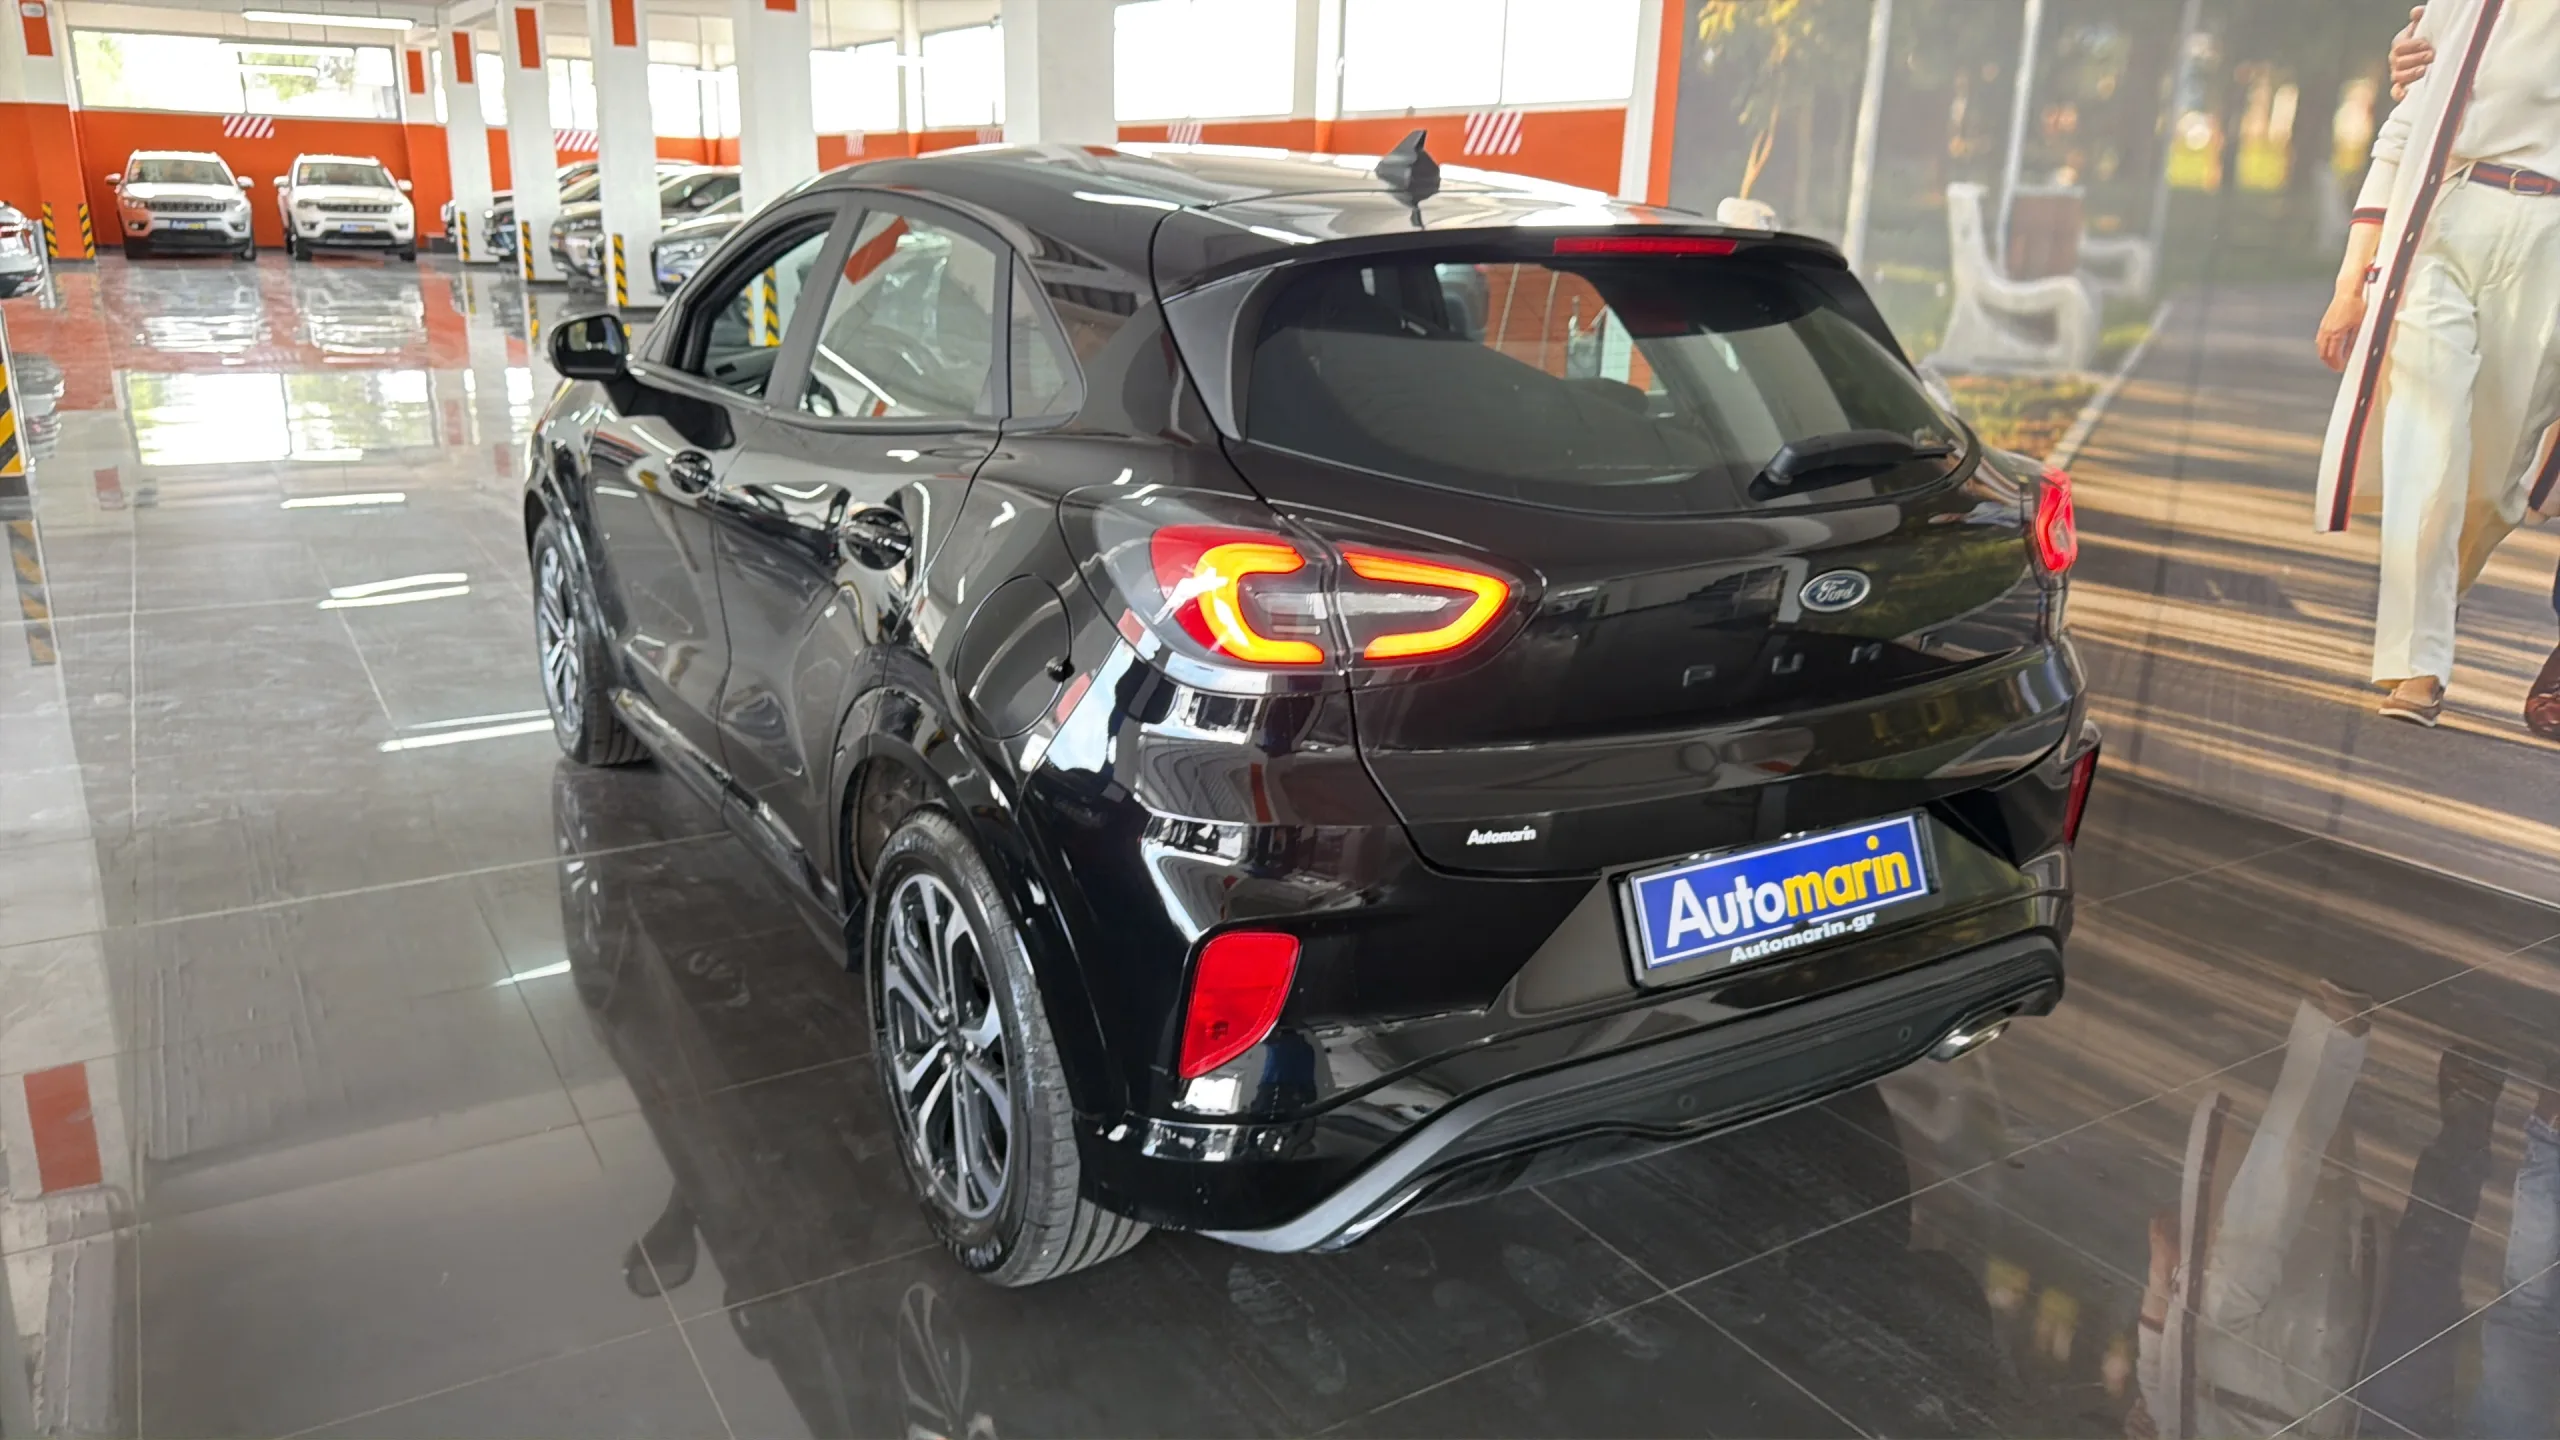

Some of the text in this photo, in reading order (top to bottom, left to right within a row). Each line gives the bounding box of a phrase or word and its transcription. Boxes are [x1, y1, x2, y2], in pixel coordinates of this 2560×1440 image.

[1815, 578, 1857, 603] Ford
[1466, 824, 1537, 846] Automarin
[1666, 835, 1912, 949] Automarin
[1730, 912, 1877, 963] Automarin.gr
